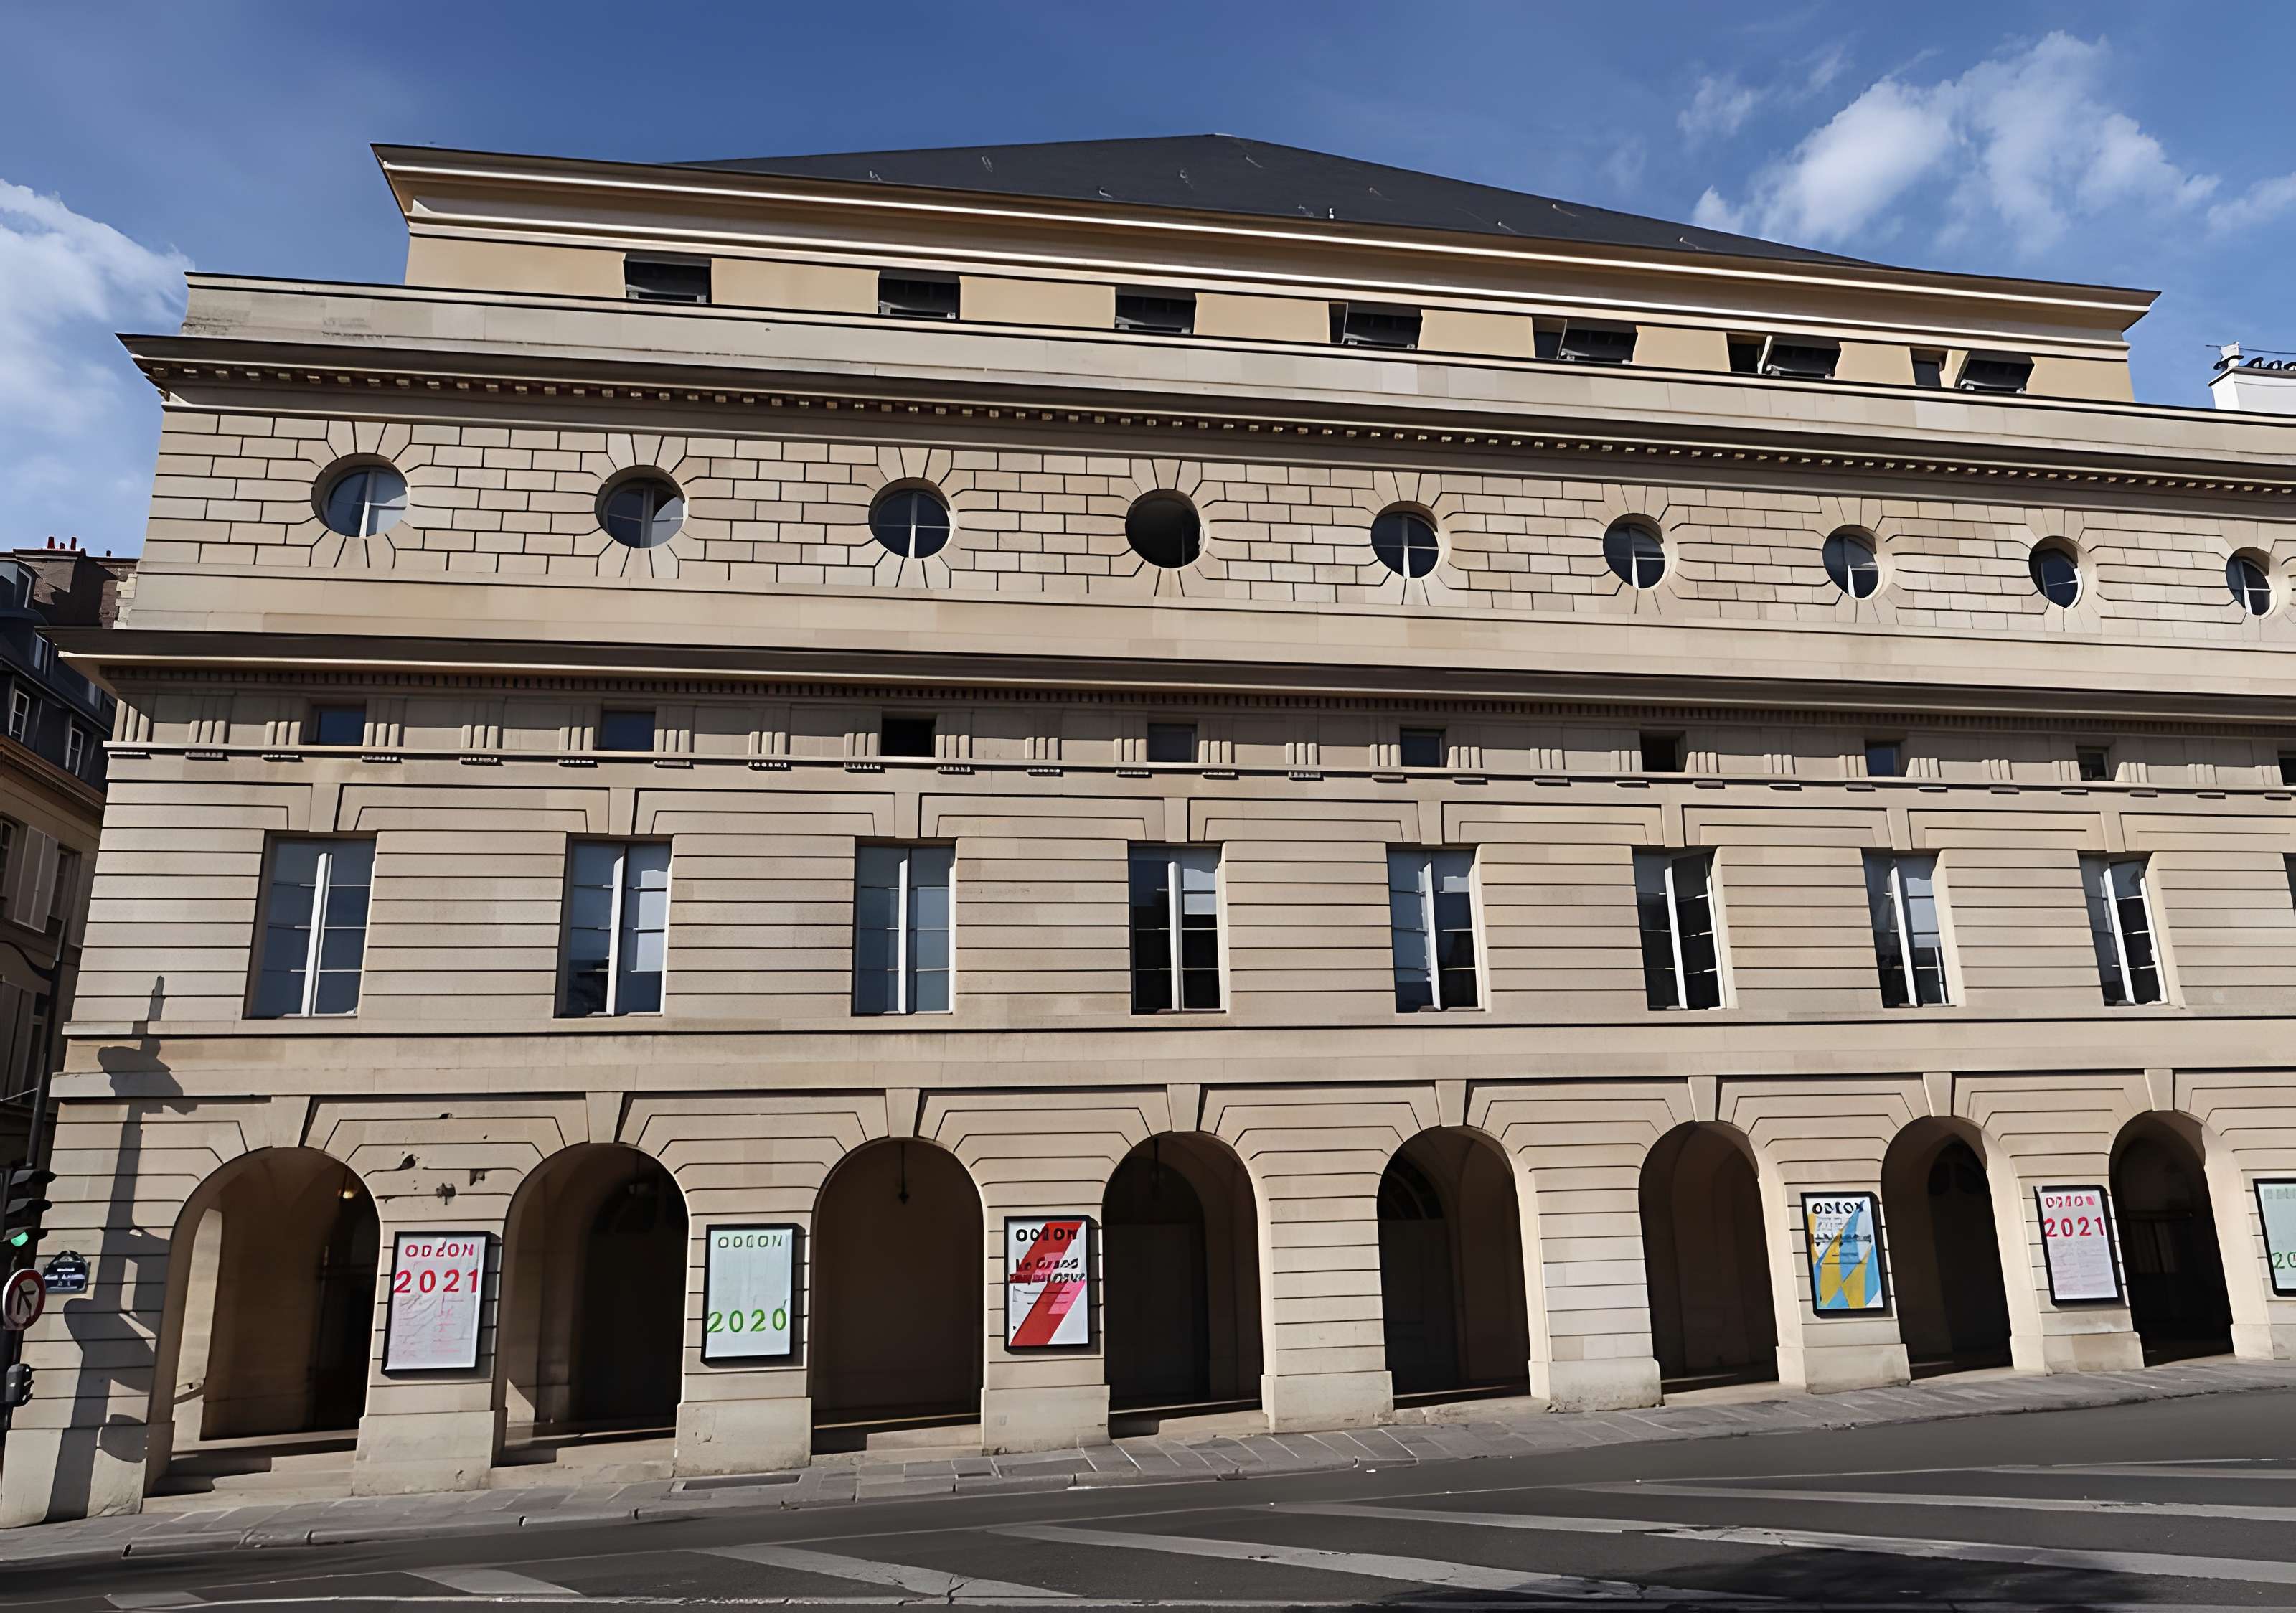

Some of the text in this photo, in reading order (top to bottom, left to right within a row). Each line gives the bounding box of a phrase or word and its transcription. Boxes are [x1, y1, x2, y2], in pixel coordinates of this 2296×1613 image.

[2044, 1216, 2104, 1237] 2021
[394, 1268, 479, 1294] 2021
[707, 1307, 786, 1333] 2020
